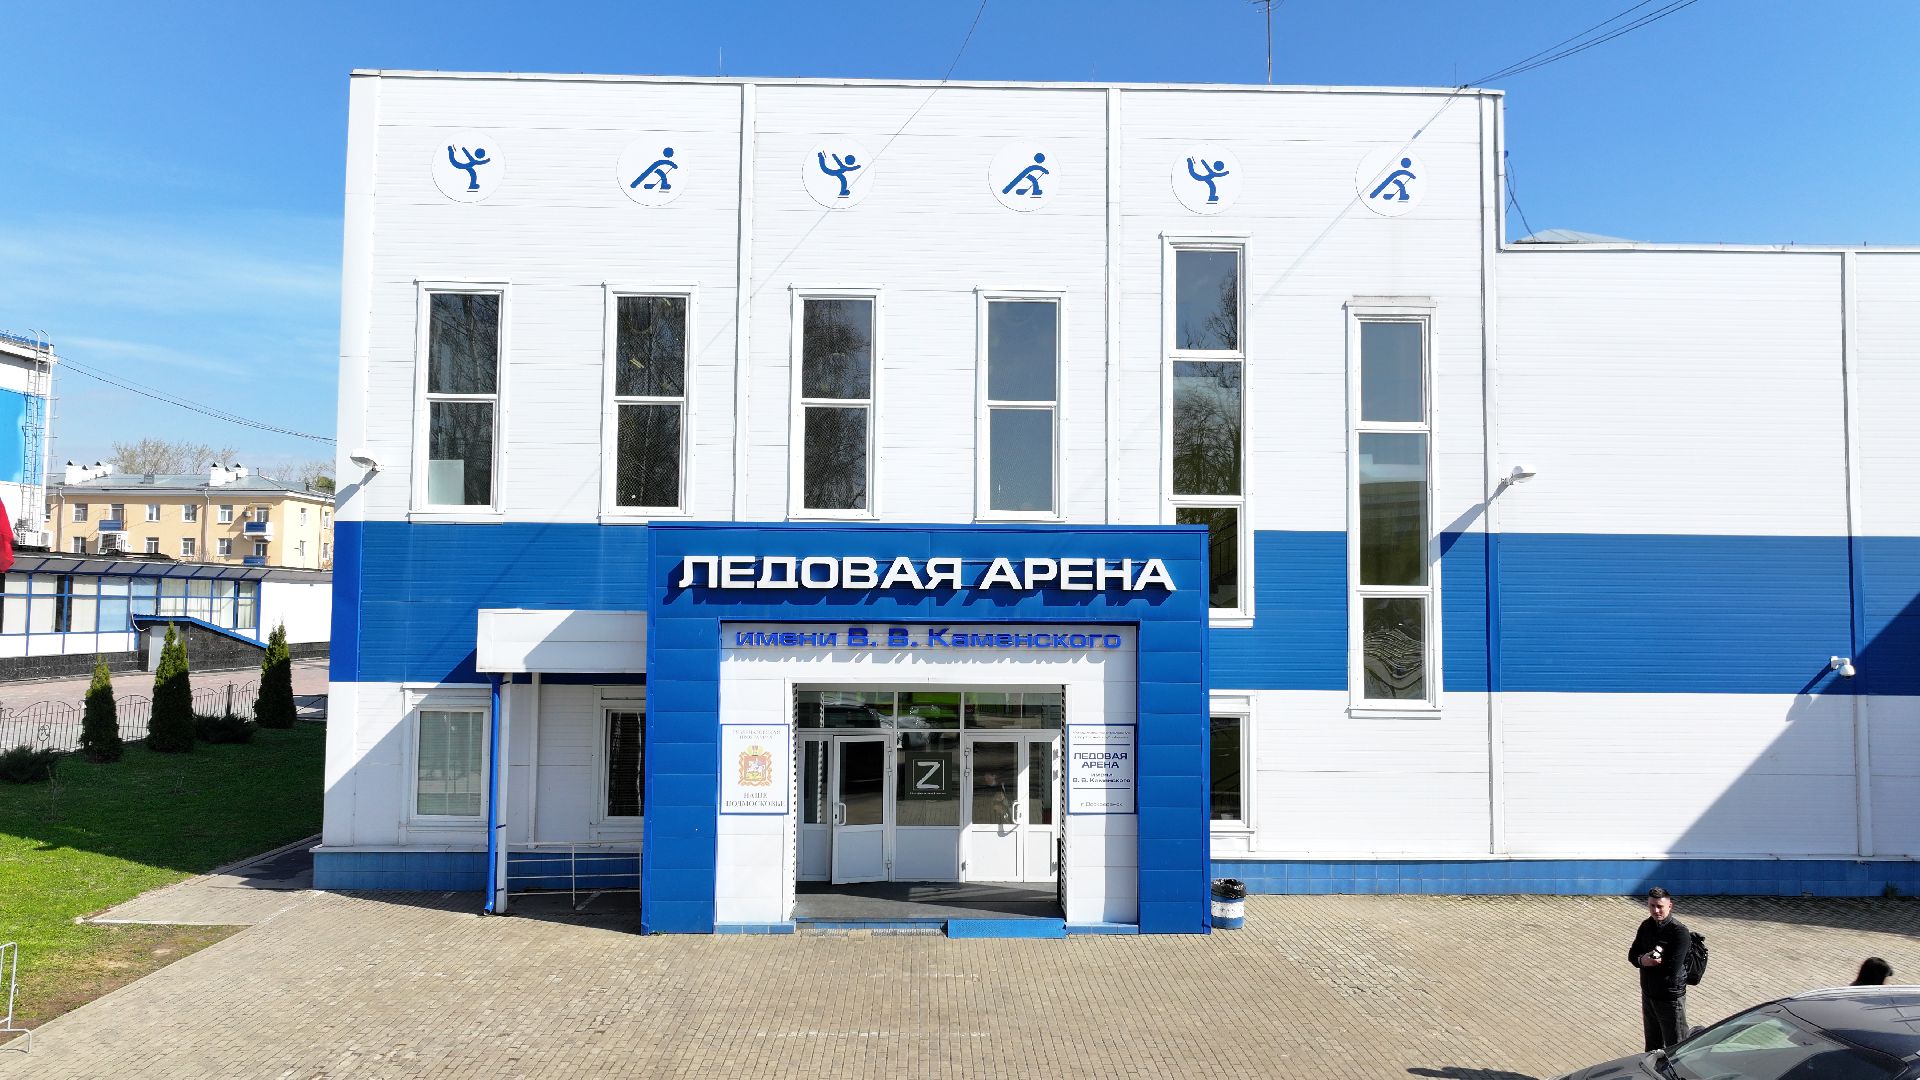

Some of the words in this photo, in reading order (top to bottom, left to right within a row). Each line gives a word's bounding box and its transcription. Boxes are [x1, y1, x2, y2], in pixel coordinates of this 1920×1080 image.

[678, 556, 962, 590] ЛЕДОВАЯ
[978, 557, 1177, 591] АРЕНА
[735, 631, 838, 648] имени
[847, 627, 878, 648] В.
[887, 628, 918, 648] В.
[928, 628, 1121, 649] Каменского
[1073, 752, 1128, 760] ЛЕДОВАЯ
[1081, 761, 1120, 769] АРЕНА
[916, 761, 941, 789] Z
